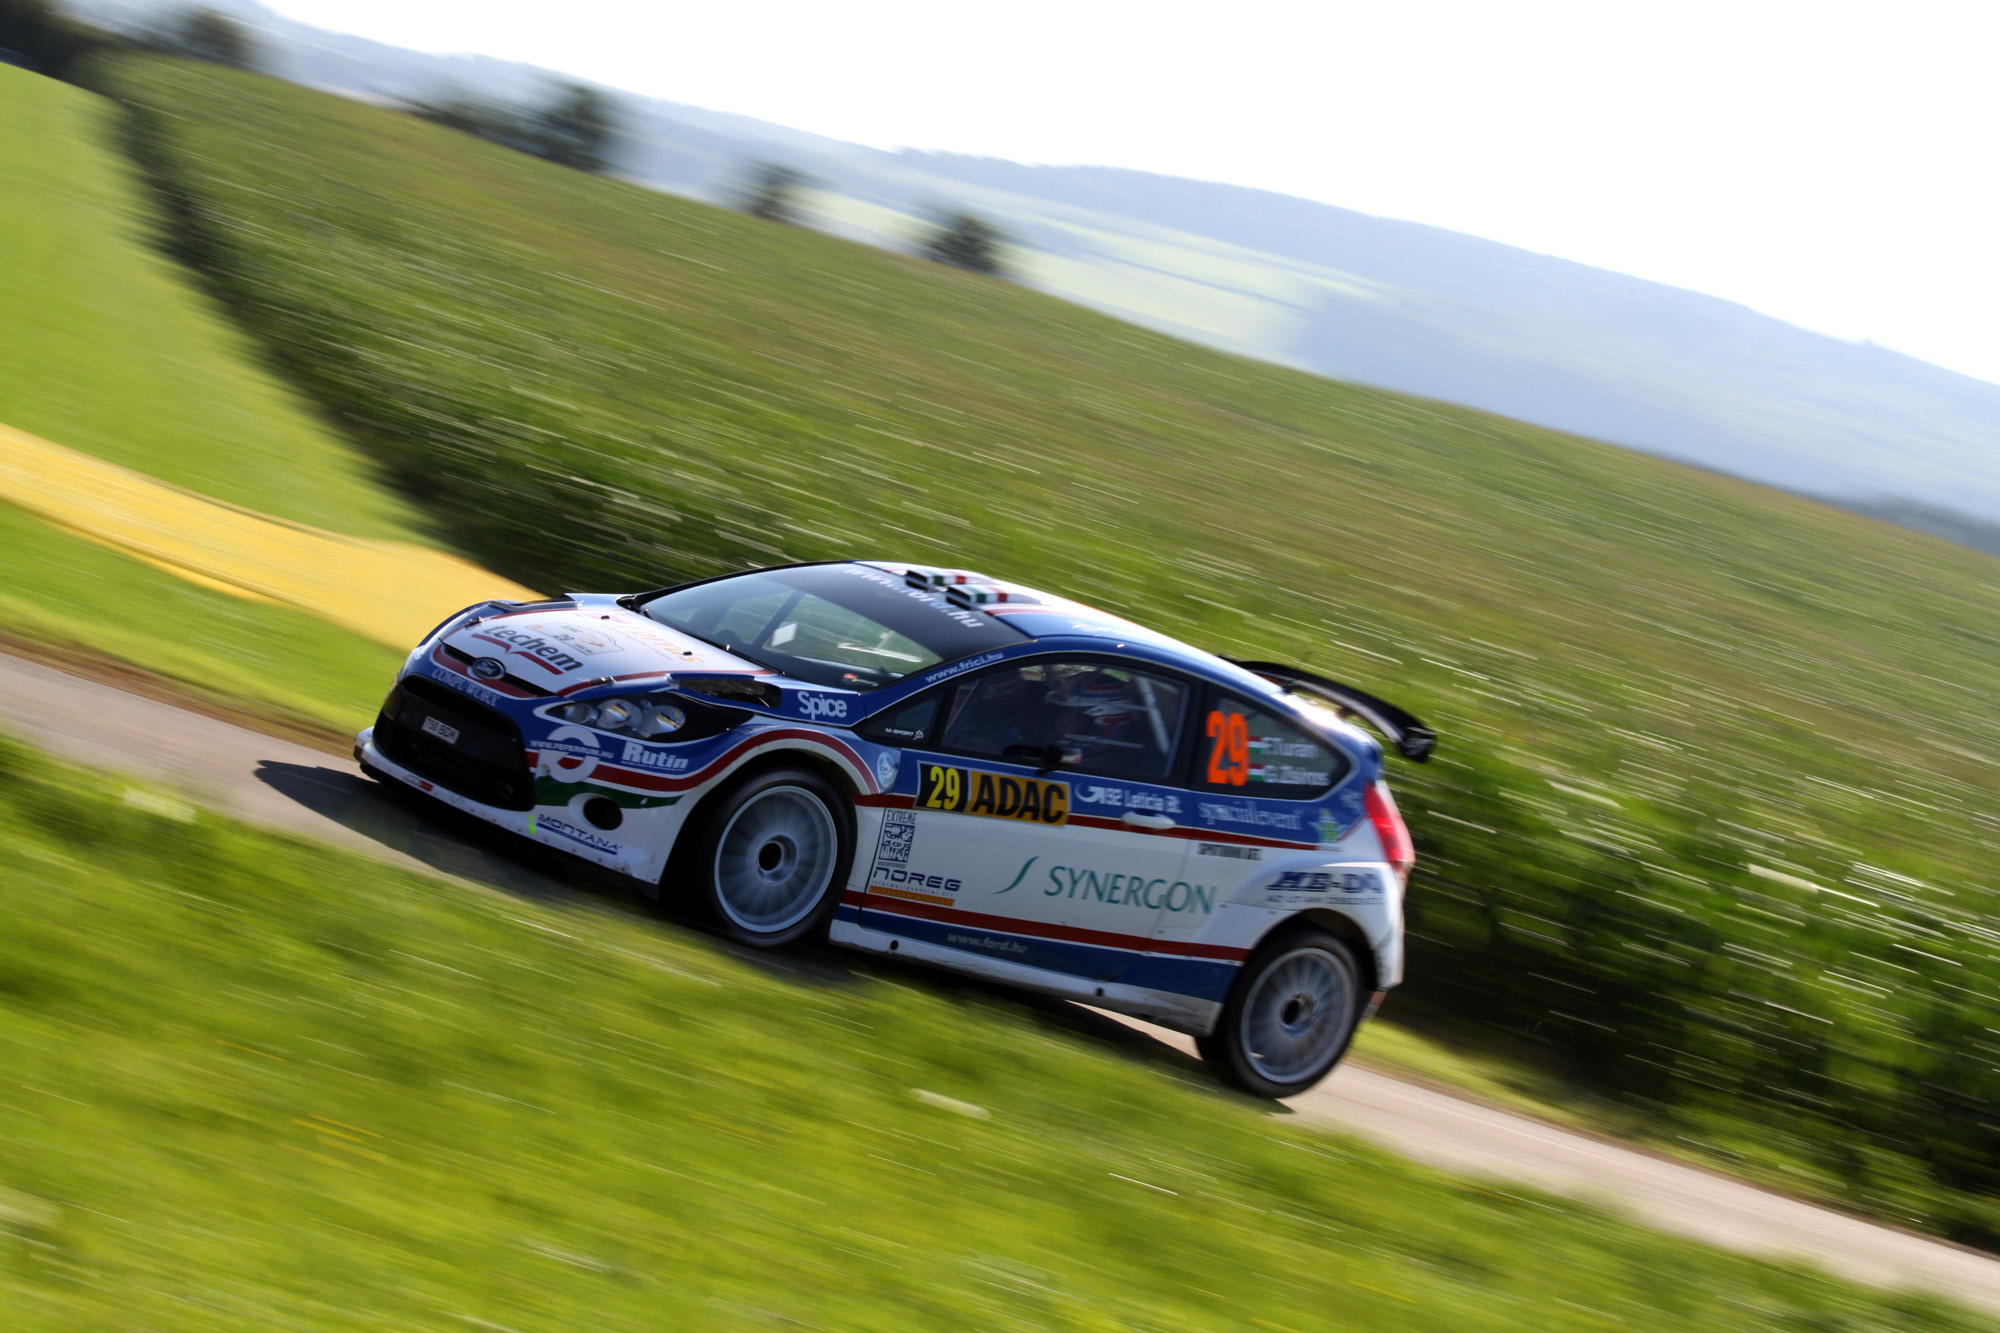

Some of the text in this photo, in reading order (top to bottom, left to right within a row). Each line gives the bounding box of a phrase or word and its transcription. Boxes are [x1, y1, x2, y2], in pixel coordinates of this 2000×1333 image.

[843, 568, 985, 628] www.ford.hu
[483, 625, 583, 672] techem
[925, 651, 1004, 683] www.frici.hu
[797, 691, 847, 721] Spice
[885, 727, 914, 738] M-SPORT
[1206, 710, 1249, 786] 29
[621, 741, 689, 769] Rutin
[927, 766, 1066, 824] 29 ADAC
[538, 814, 619, 851] MONTANA
[886, 809, 917, 825] EXTREME
[873, 867, 961, 891] NOREG
[1044, 865, 1218, 915] SYNERGON
